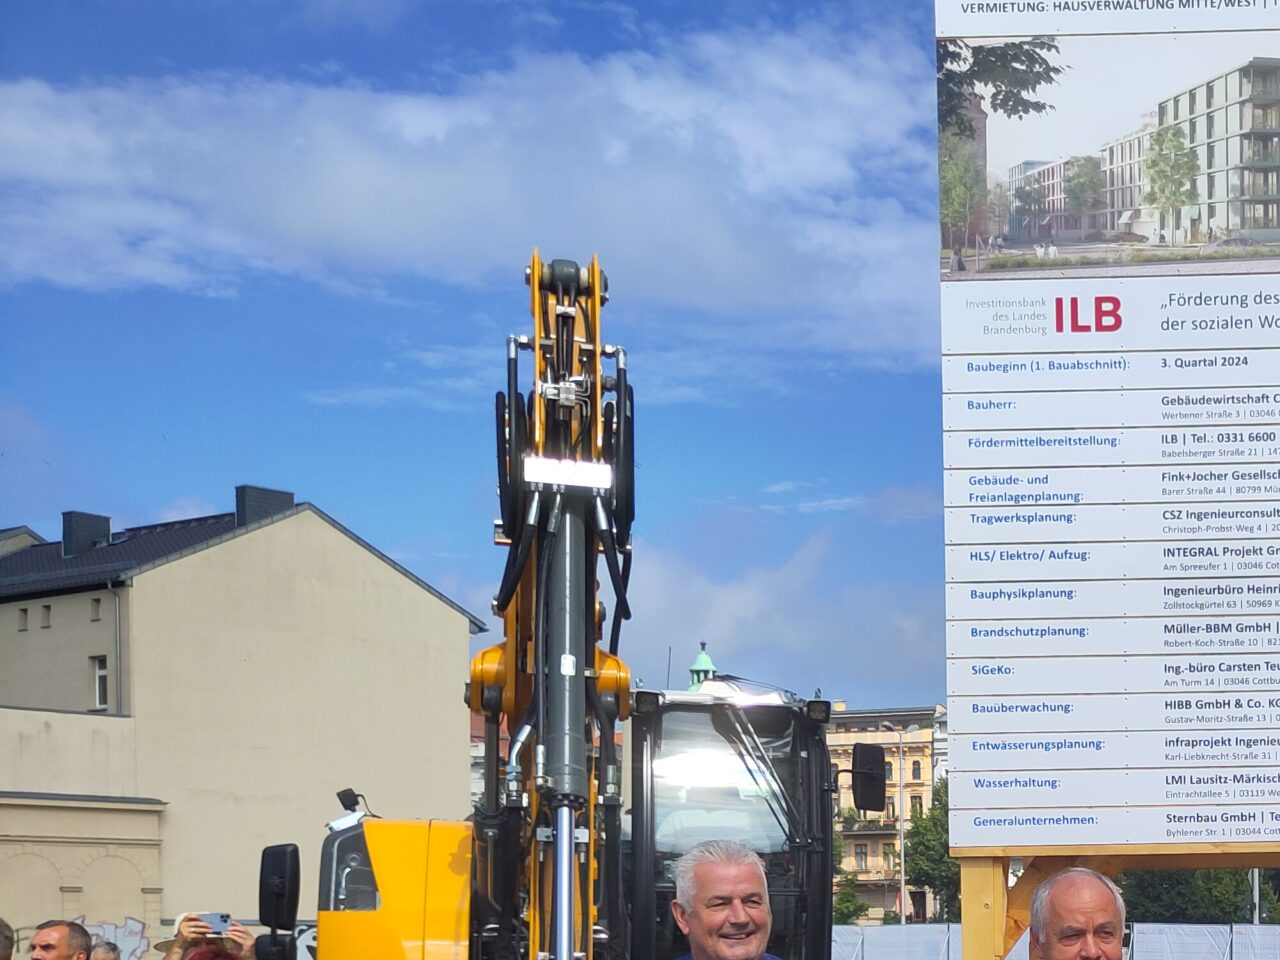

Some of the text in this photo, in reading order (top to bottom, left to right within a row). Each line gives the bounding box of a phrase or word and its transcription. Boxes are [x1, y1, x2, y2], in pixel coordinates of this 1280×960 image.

[961, 2, 1049, 13] VERMIETUNG:
[1053, 0, 1175, 12] HAUSVERWALTUNG
[965, 297, 1047, 308] Investitionsbank
[1160, 292, 1248, 309] „Förderung
[1253, 290, 1280, 305] des
[992, 311, 1047, 322] des Landes
[1055, 295, 1123, 333] ILB
[1160, 316, 1187, 331] der
[1191, 315, 1253, 330] sozialen
[983, 325, 1048, 336] Brandenburg
[967, 358, 1130, 373] Baubeginn (1. Bauabschnitt):
[1160, 356, 1248, 369] 3. Quartal 2024
[967, 400, 1016, 410] Bauherr:
[1161, 393, 1270, 406] Gebäudewirtschaft
[968, 436, 1120, 447] Fördermittelbereitstellung:
[1161, 431, 1276, 444] ILB Tel.: 0331 6600
[968, 474, 1048, 486] Gebäude- und
[1161, 471, 1228, 482] Fink+Jocher
[969, 493, 1084, 504] Freianlagenplanung:
[971, 512, 1076, 525] Tragwerksplanung:
[1162, 509, 1183, 520] CSZ
[1186, 508, 1280, 521] Ingenieurconsult
[1162, 524, 1254, 534] Christoph-Probst-Weg
[1256, 523, 1262, 531] 4
[969, 549, 1090, 562] HLS/ Elektro/ Aufzug:
[1163, 547, 1220, 558] INTEGRAL
[1222, 545, 1264, 558] Projekt
[970, 588, 1077, 601] Bauphysikplanung:
[1163, 584, 1244, 598] Ingenieurbüro
[970, 626, 1089, 638] Brandschutzplanung:
[1163, 623, 1232, 634] Müller-BBM
[1235, 622, 1271, 633] GmbH
[1163, 638, 1245, 647] Robert-Koch-Straße
[1247, 638, 1258, 647] 10
[971, 665, 1014, 675] SiGeKo:
[1164, 662, 1216, 675] Ing.-büro
[1218, 662, 1261, 672] Carsten
[972, 702, 1074, 714] Bauüberwachung:
[1164, 699, 1192, 710] HIBB
[1195, 698, 1231, 710] GmbH
[1244, 698, 1264, 709] Co.
[972, 740, 1105, 751] Entwässerungsplanung:
[1164, 736, 1232, 749] infraprojekt
[1164, 752, 1259, 761] Karl-Liebknecht-Straße
[1261, 751, 1271, 760] 31
[973, 778, 1060, 789] Wasserhaltung:
[1165, 775, 1186, 785] LMI
[973, 816, 1098, 826] Generalunternehmen:
[1166, 813, 1217, 823] Sternbau
[1220, 812, 1256, 822] GmbH
